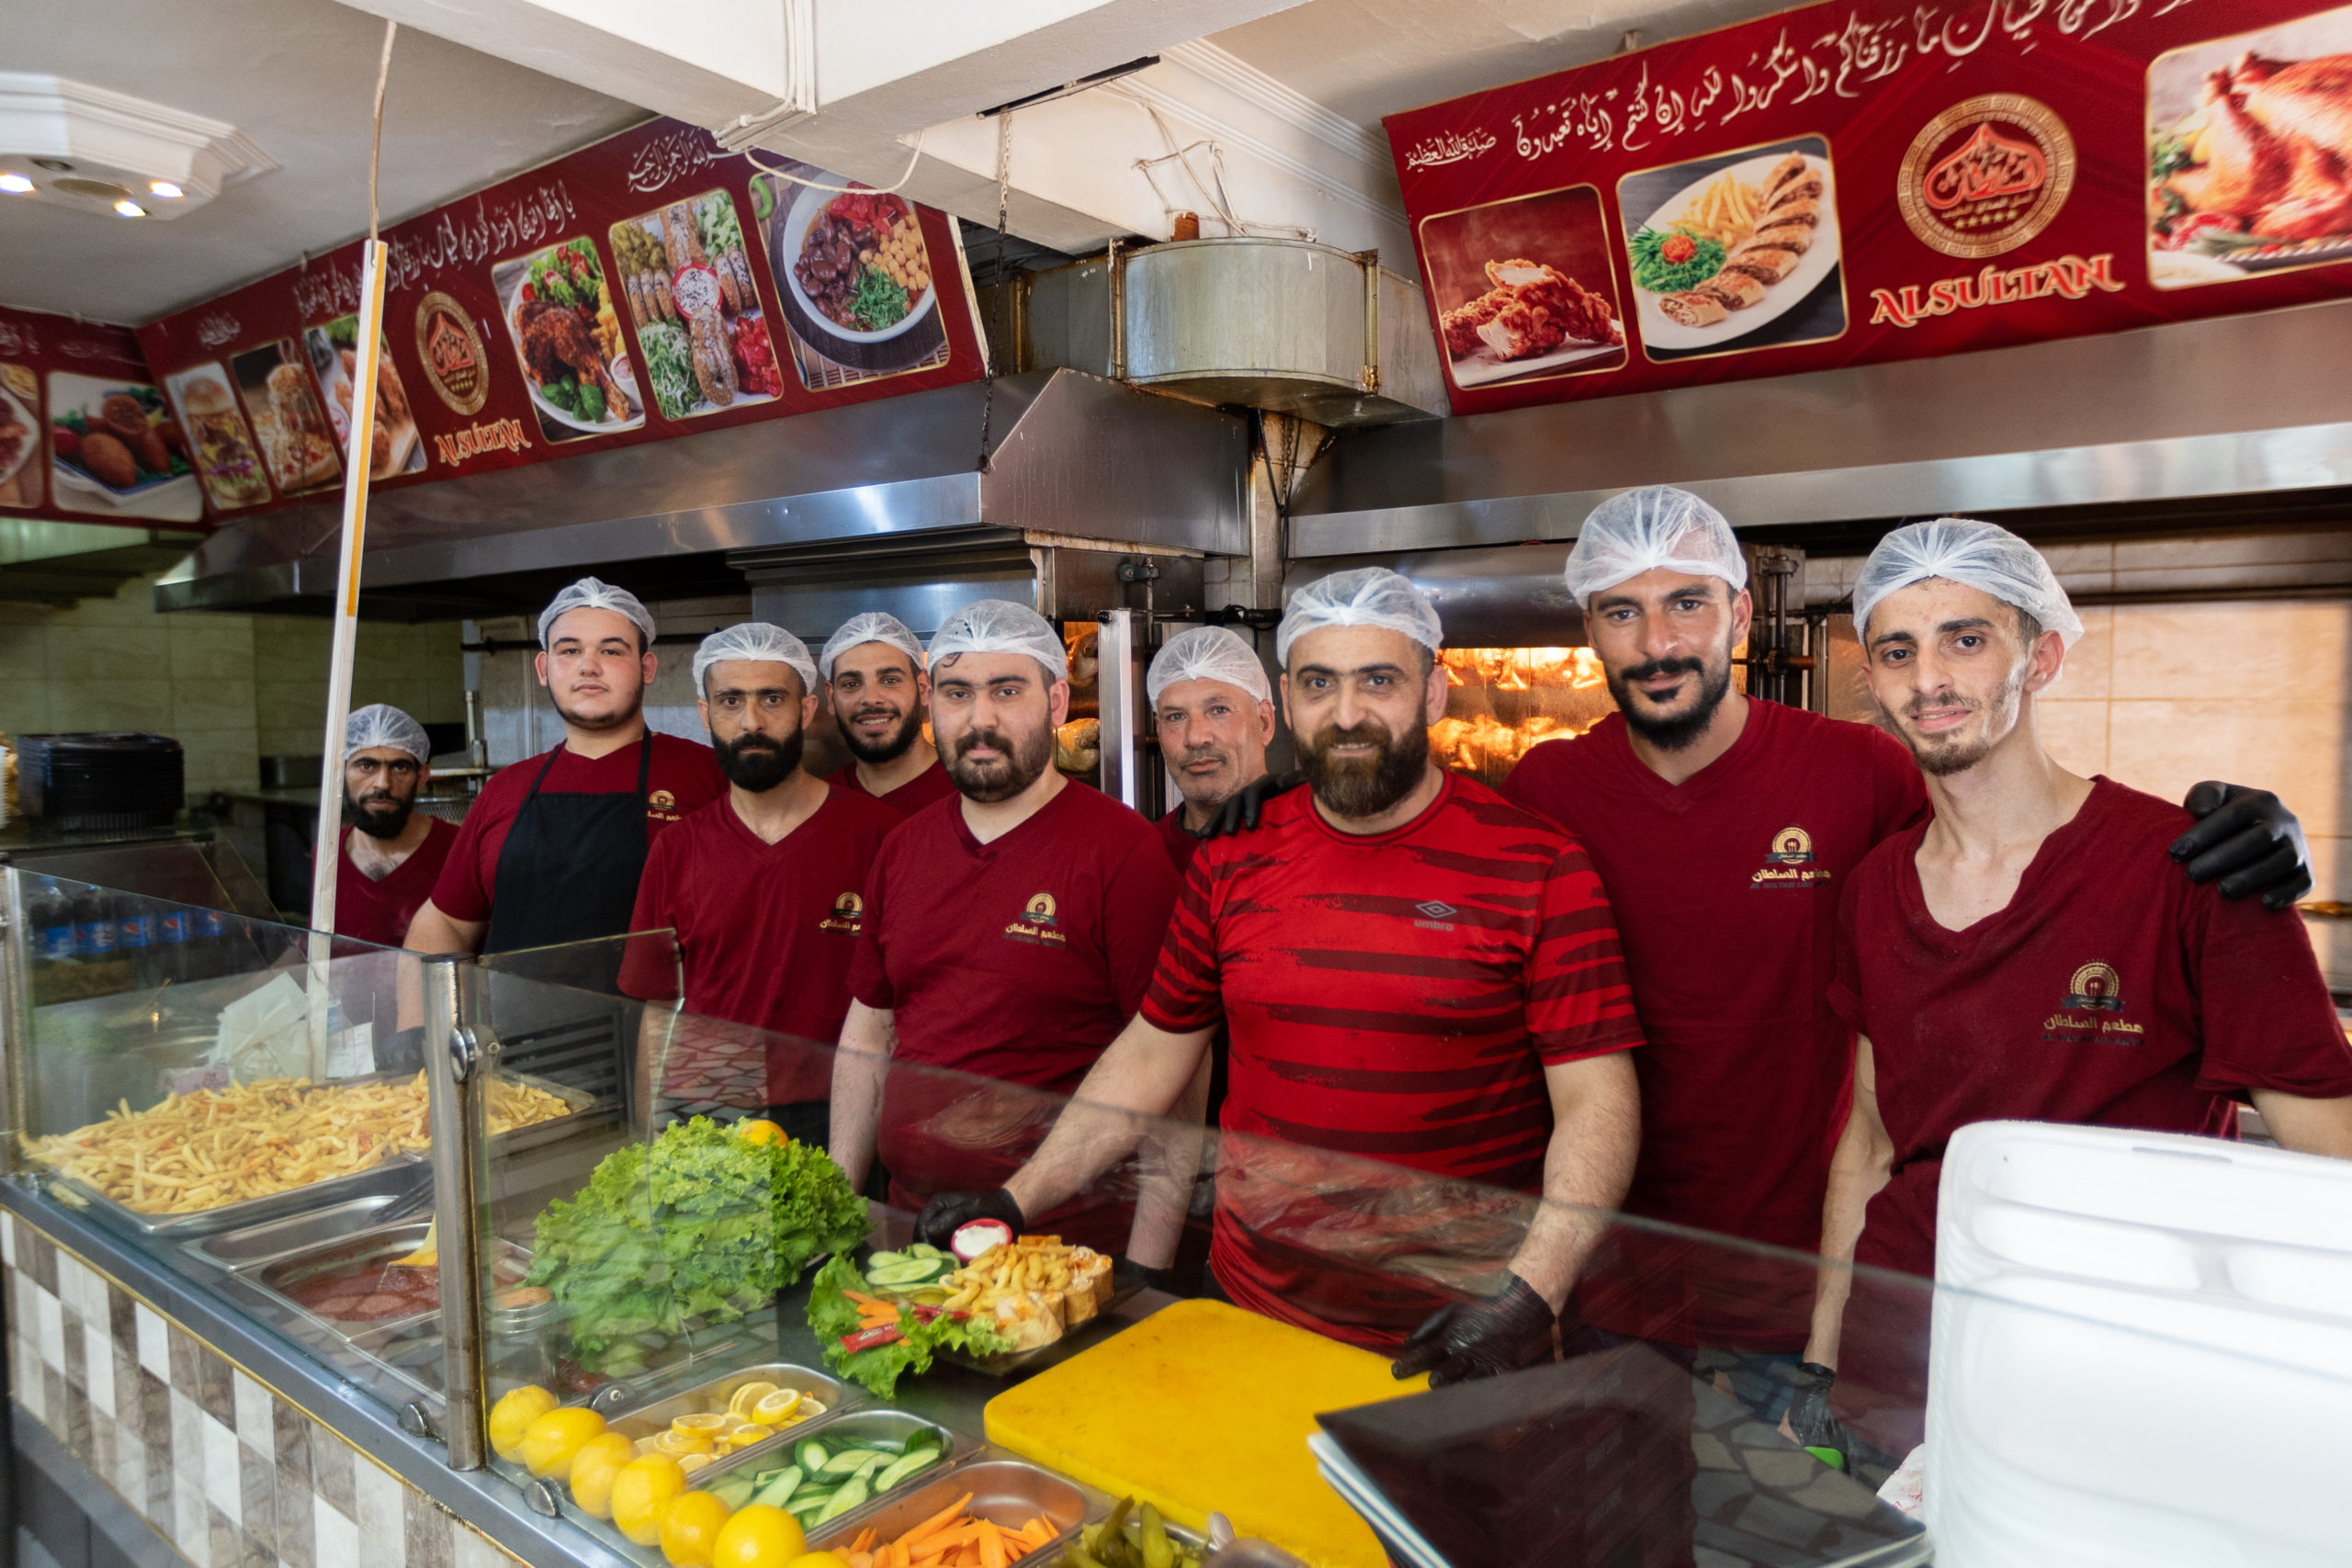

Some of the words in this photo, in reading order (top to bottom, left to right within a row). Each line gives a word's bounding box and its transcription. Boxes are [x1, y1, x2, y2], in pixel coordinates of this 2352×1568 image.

[1869, 254, 2127, 328] ALSULTAN
[434, 418, 532, 467] ALSULTAN
[1751, 869, 1798, 882] السلطان
[1005, 923, 1038, 935] السلطان
[1414, 920, 1454, 932] umbro
[2043, 1014, 2098, 1030] السلطان
[2102, 1019, 2144, 1033] مطعم
